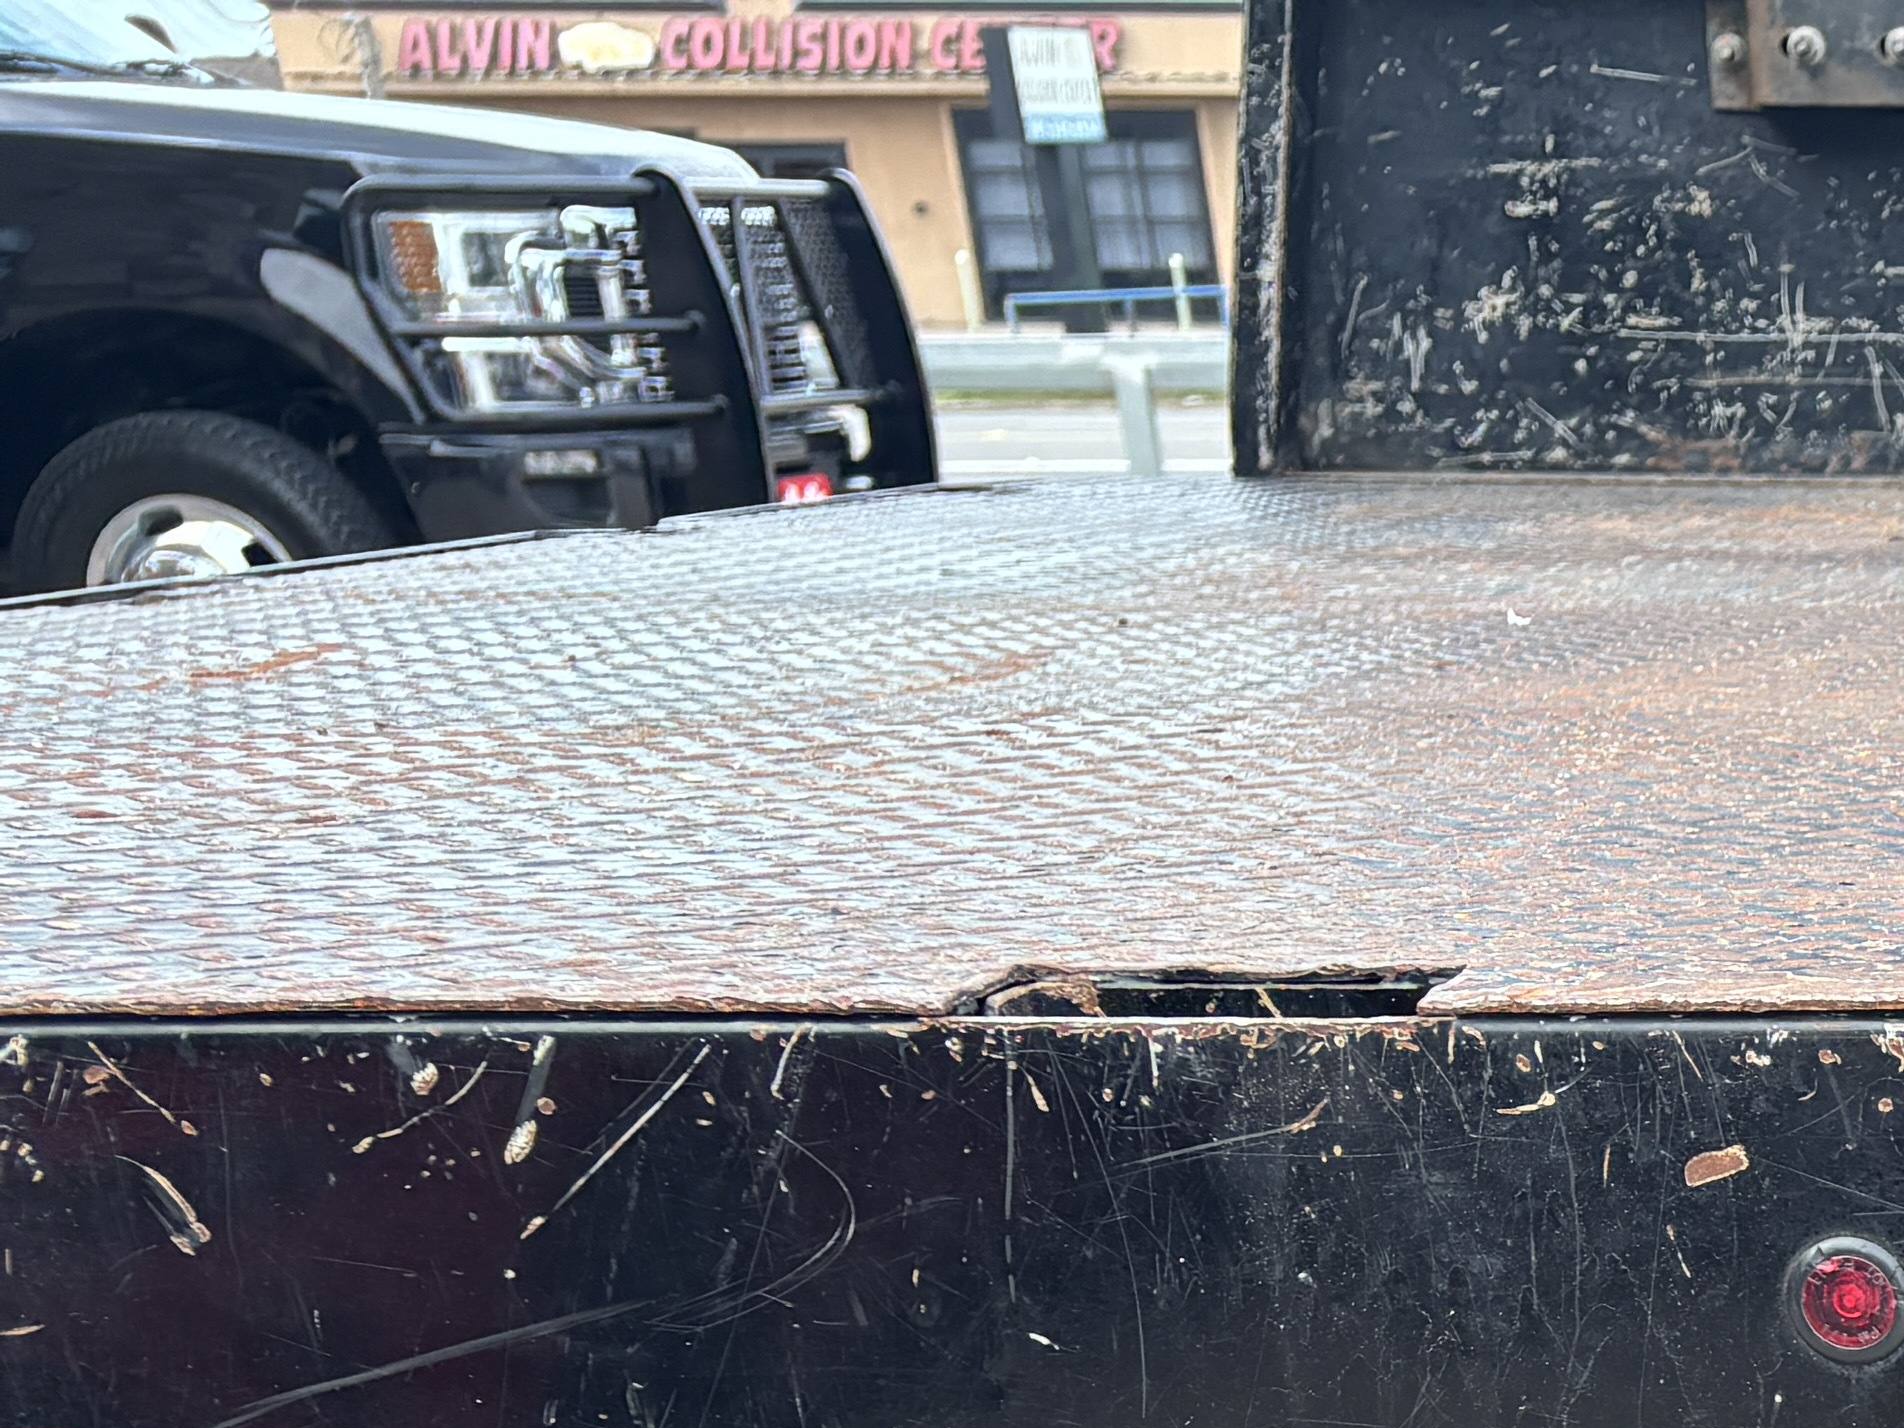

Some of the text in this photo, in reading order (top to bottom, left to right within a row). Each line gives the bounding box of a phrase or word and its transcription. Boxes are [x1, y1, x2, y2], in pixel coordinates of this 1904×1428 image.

[400, 17, 551, 71] ALVIN
[661, 16, 912, 71] COLLISION
[930, 15, 1121, 71] CER
